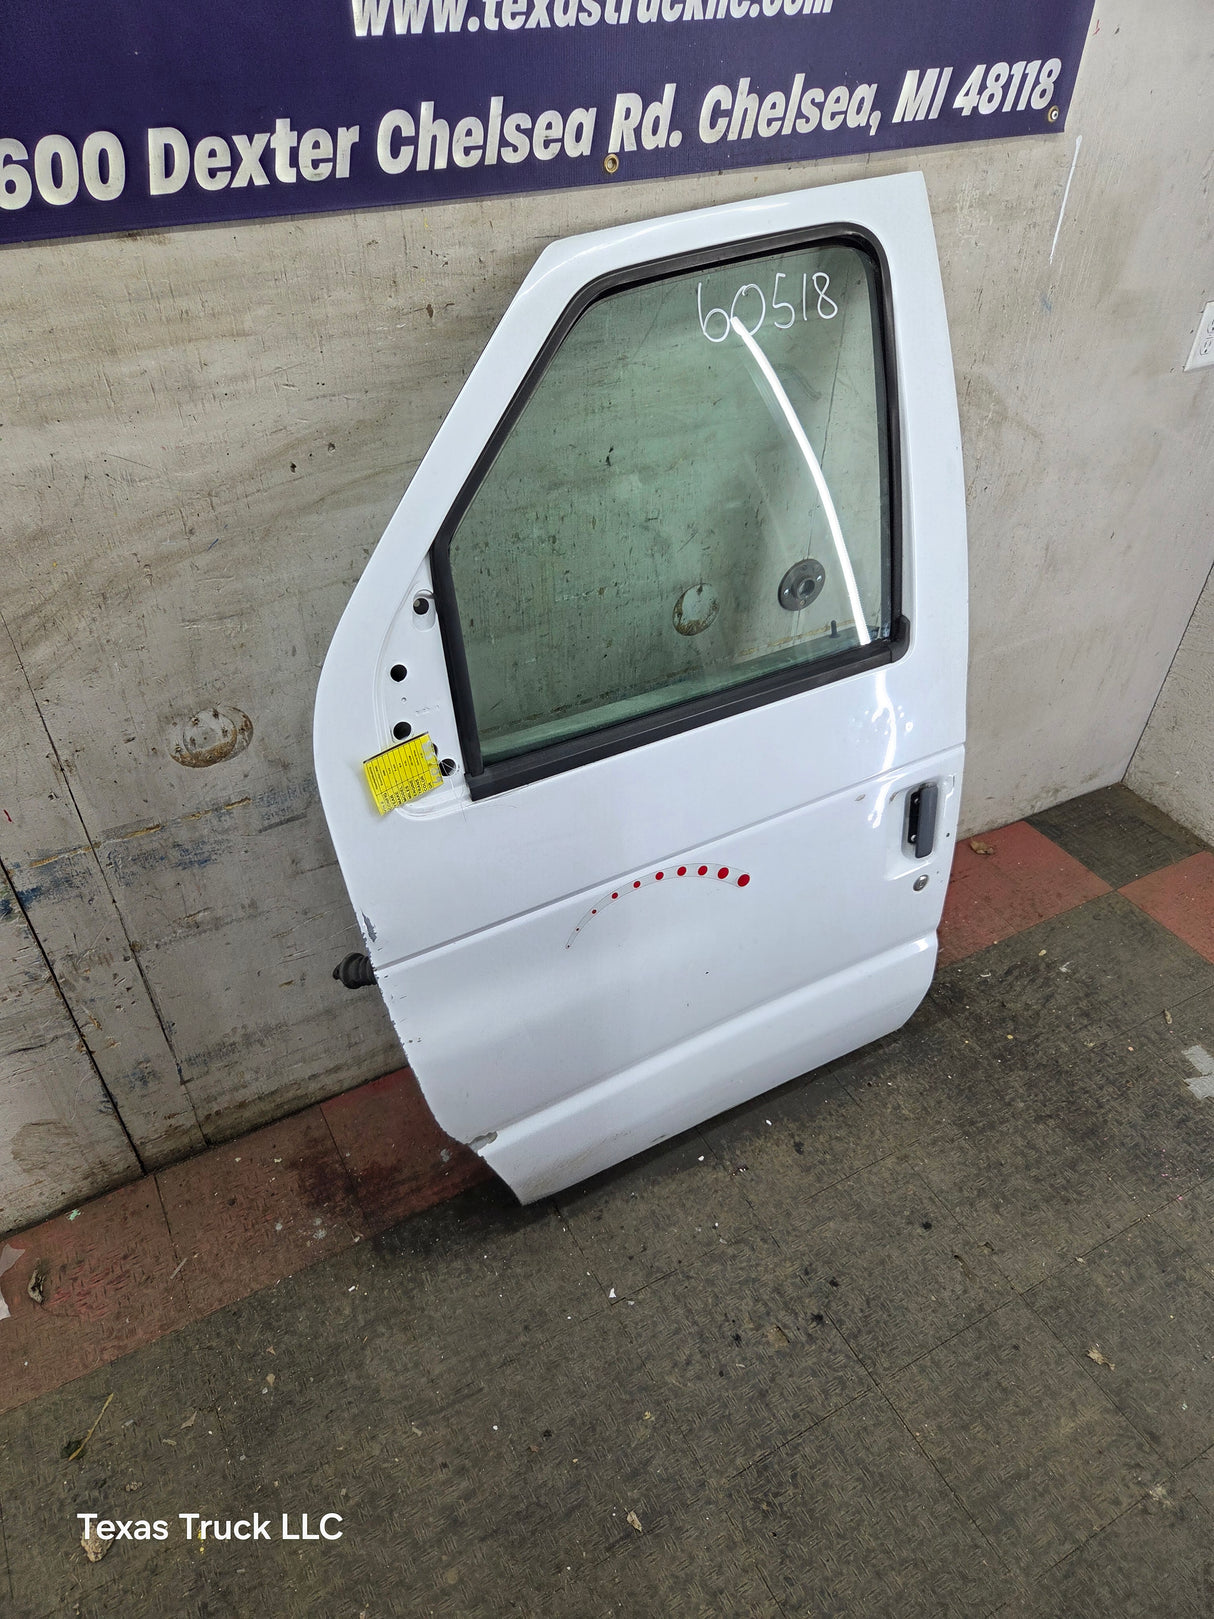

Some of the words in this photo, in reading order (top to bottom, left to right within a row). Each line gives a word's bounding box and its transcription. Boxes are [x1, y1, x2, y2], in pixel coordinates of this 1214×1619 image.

[0, 131, 126, 211] 600
[148, 119, 360, 196] Dexter
[377, 96, 597, 175] Chelsea
[607, 83, 683, 154] Rd.
[699, 73, 882, 137] Chelsea,
[892, 67, 953, 123] MI
[953, 58, 1062, 116] 48118
[697, 271, 838, 343] 60518
